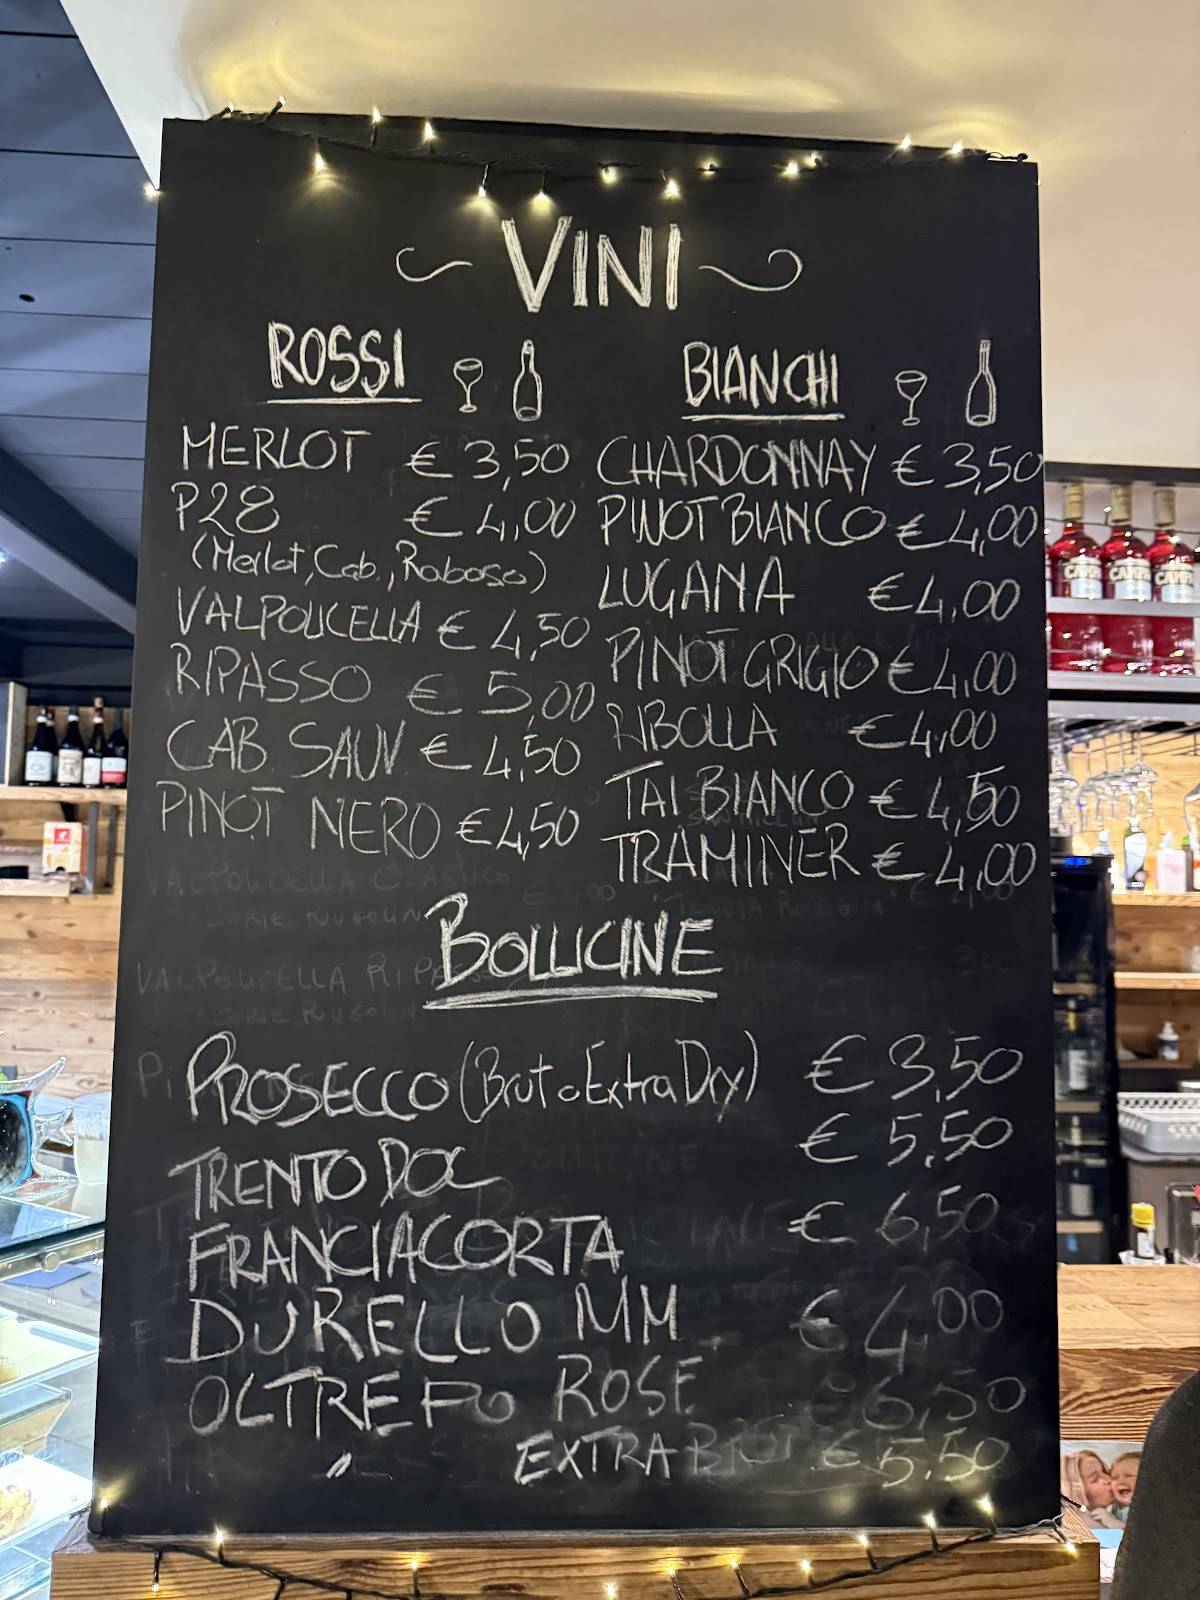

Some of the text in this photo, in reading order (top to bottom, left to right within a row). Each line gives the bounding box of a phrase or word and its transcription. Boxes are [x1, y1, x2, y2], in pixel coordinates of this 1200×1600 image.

[502, 216, 681, 312] VINI
[268, 321, 406, 397] ROSSI
[683, 341, 838, 408] BIANCHI
[182, 422, 371, 472] MERLOT
[597, 435, 876, 495] CHARDONNAY
[171, 481, 280, 536] P28
[598, 494, 720, 547] PINOT
[721, 493, 886, 547] BIANCO
[598, 556, 795, 618] LUGANA
[171, 642, 371, 702] RIPASSO
[606, 627, 739, 690] PINOT
[743, 634, 879, 698] GRIGIO
[606, 699, 777, 751] RIBOLLA
[156, 781, 284, 840] PINOT
[311, 796, 440, 859] NERO
[606, 761, 678, 819] TAI
[697, 765, 854, 821] BIANCO
[601, 823, 861, 887] TRAMINER
[186, 1031, 449, 1128] PROSECCO
[585, 1039, 678, 1109] Extra
[169, 1146, 368, 1220] TRENTO
[378, 1136, 503, 1207] DOC
[188, 1210, 624, 1291] FRANCIACORTA
[165, 1286, 542, 1363] DURELLO
[514, 1424, 679, 1485] EXTRA
